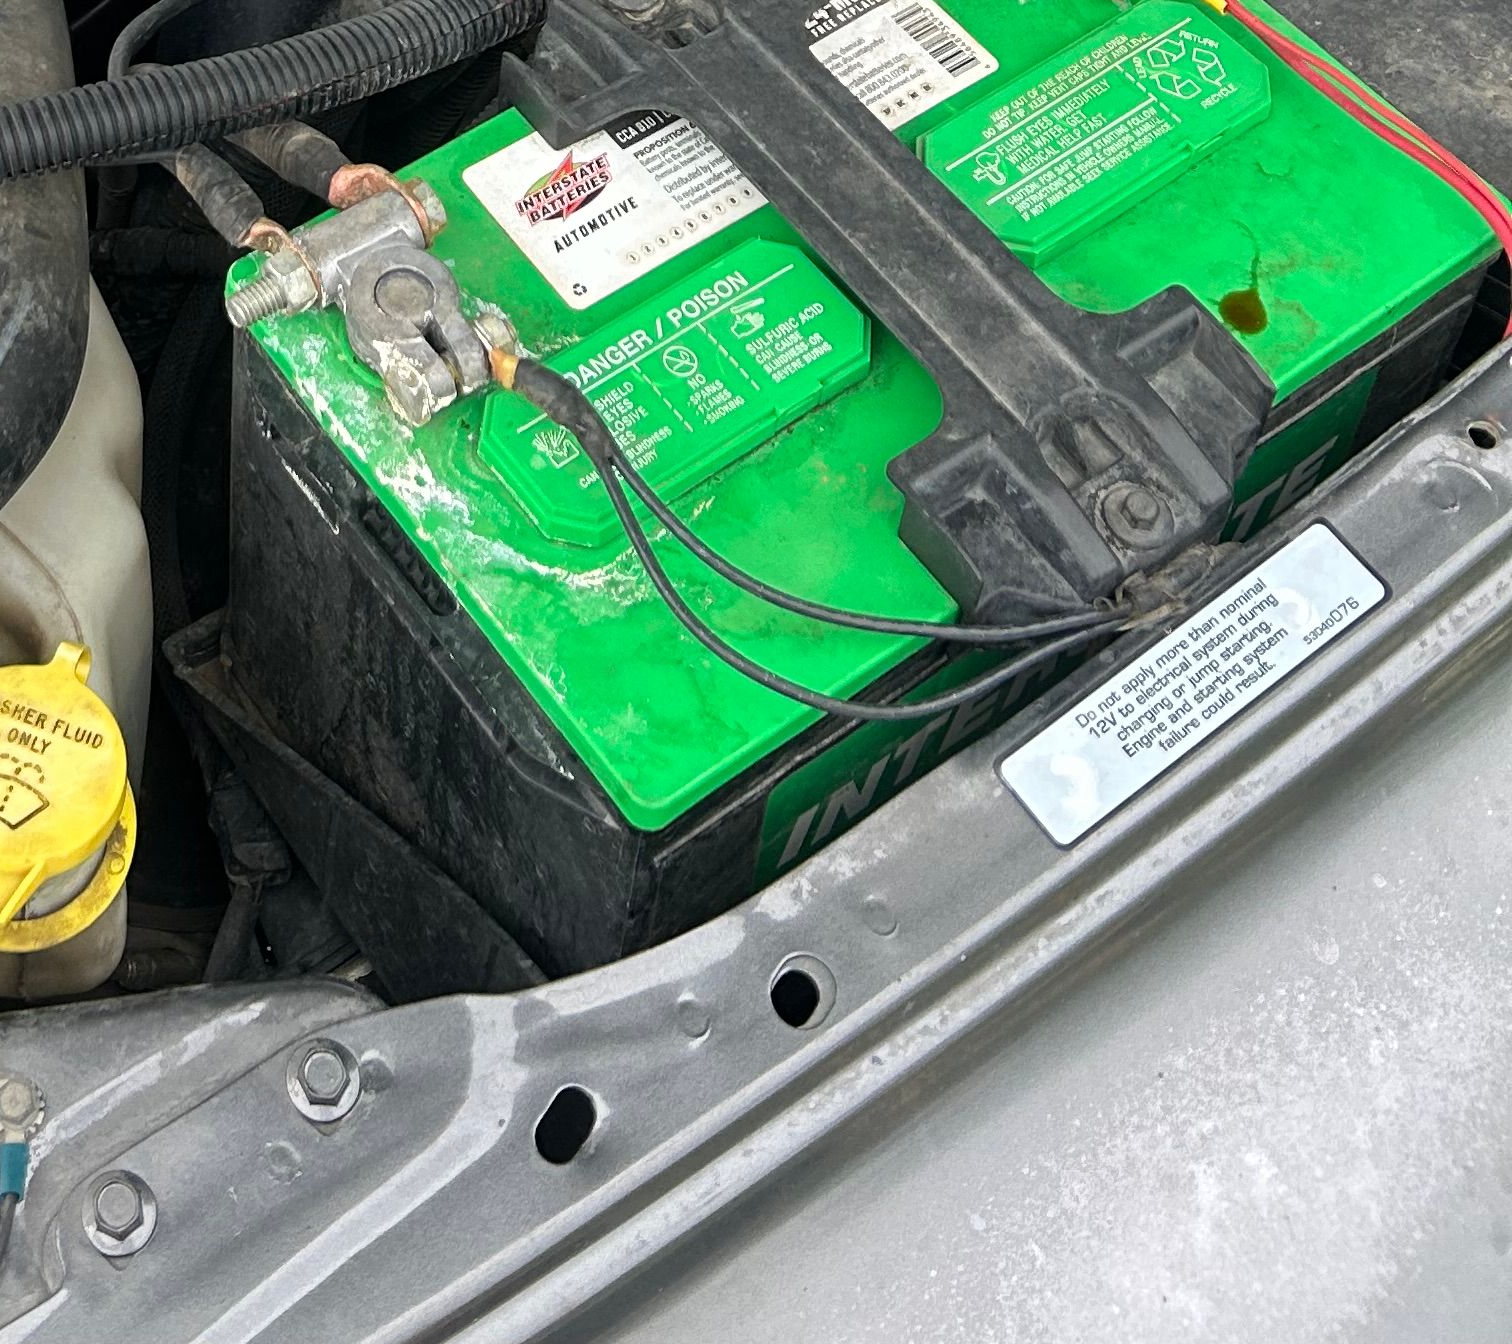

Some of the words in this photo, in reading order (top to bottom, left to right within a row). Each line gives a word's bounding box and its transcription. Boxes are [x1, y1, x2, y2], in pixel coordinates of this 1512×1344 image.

[810, 19, 838, 38] FREE
[1178, 30, 1219, 49] RETURN
[1039, 78, 1057, 94] THE
[1056, 64, 1081, 86] REACH
[1091, 34, 1129, 62] CHILDREN
[1132, 56, 1148, 80] LEAD
[1200, 82, 1238, 109] RECYCLE
[995, 130, 1028, 156] FLUSH
[1026, 115, 1054, 138] EYES
[1053, 78, 1111, 121] IMMEDIATELY
[995, 117, 1013, 132] NOT
[615, 127, 639, 143] CCA
[633, 125, 689, 159] PROPOSITION
[1006, 140, 1033, 164] WITH
[1066, 109, 1087, 128] GET
[1017, 145, 1059, 176] MEDICAL
[1057, 129, 1083, 153] HELP
[1082, 113, 1108, 135] FAST
[515, 153, 609, 216] INTERSTATE
[529, 171, 612, 226] BATTERIES
[553, 196, 639, 253] AUTOMOTIVE
[563, 329, 654, 391] DANGER
[666, 271, 749, 328] POISON
[745, 317, 800, 356] SULFURIC
[799, 302, 825, 327] ACID
[755, 349, 773, 365] CAN
[773, 331, 803, 355] CAUSE
[763, 343, 808, 375] BLINDNESS
[807, 333, 824, 346] OR
[593, 382, 634, 412] SHIELD
[686, 374, 706, 390] NO
[690, 379, 724, 406] SPARKS
[603, 399, 633, 423] EYES
[698, 389, 732, 415] FLAMES
[706, 395, 745, 423] SMOKING
[611, 407, 649, 435] LOSIVE
[625, 426, 673, 460] BLINDNESS
[1075, 709, 1097, 729] Do
[1097, 691, 1121, 712] not
[1121, 666, 1156, 698] apply
[1155, 638, 1189, 669] more
[1188, 614, 1220, 642] than
[1219, 576, 1268, 620] nominal
[1089, 715, 1117, 739] 12V
[1117, 702, 1136, 717] to
[1136, 657, 1192, 706] electrical
[1192, 624, 1238, 663] system
[1237, 592, 1280, 628] during
[1116, 695, 1174, 742] charging
[1171, 686, 1186, 702] or
[1187, 659, 1220, 689] jump
[1220, 619, 1274, 663] starting.
[1121, 719, 1169, 758] Engine
[1167, 699, 1194, 725] and
[1193, 662, 1245, 705] starting
[1242, 627, 1289, 668] system
[1159, 714, 1201, 753] failure
[1201, 687, 1236, 721] could
[1235, 661, 1277, 695] result.
[7, 727, 52, 754] ONLY
[51, 719, 104, 750] FLUID
